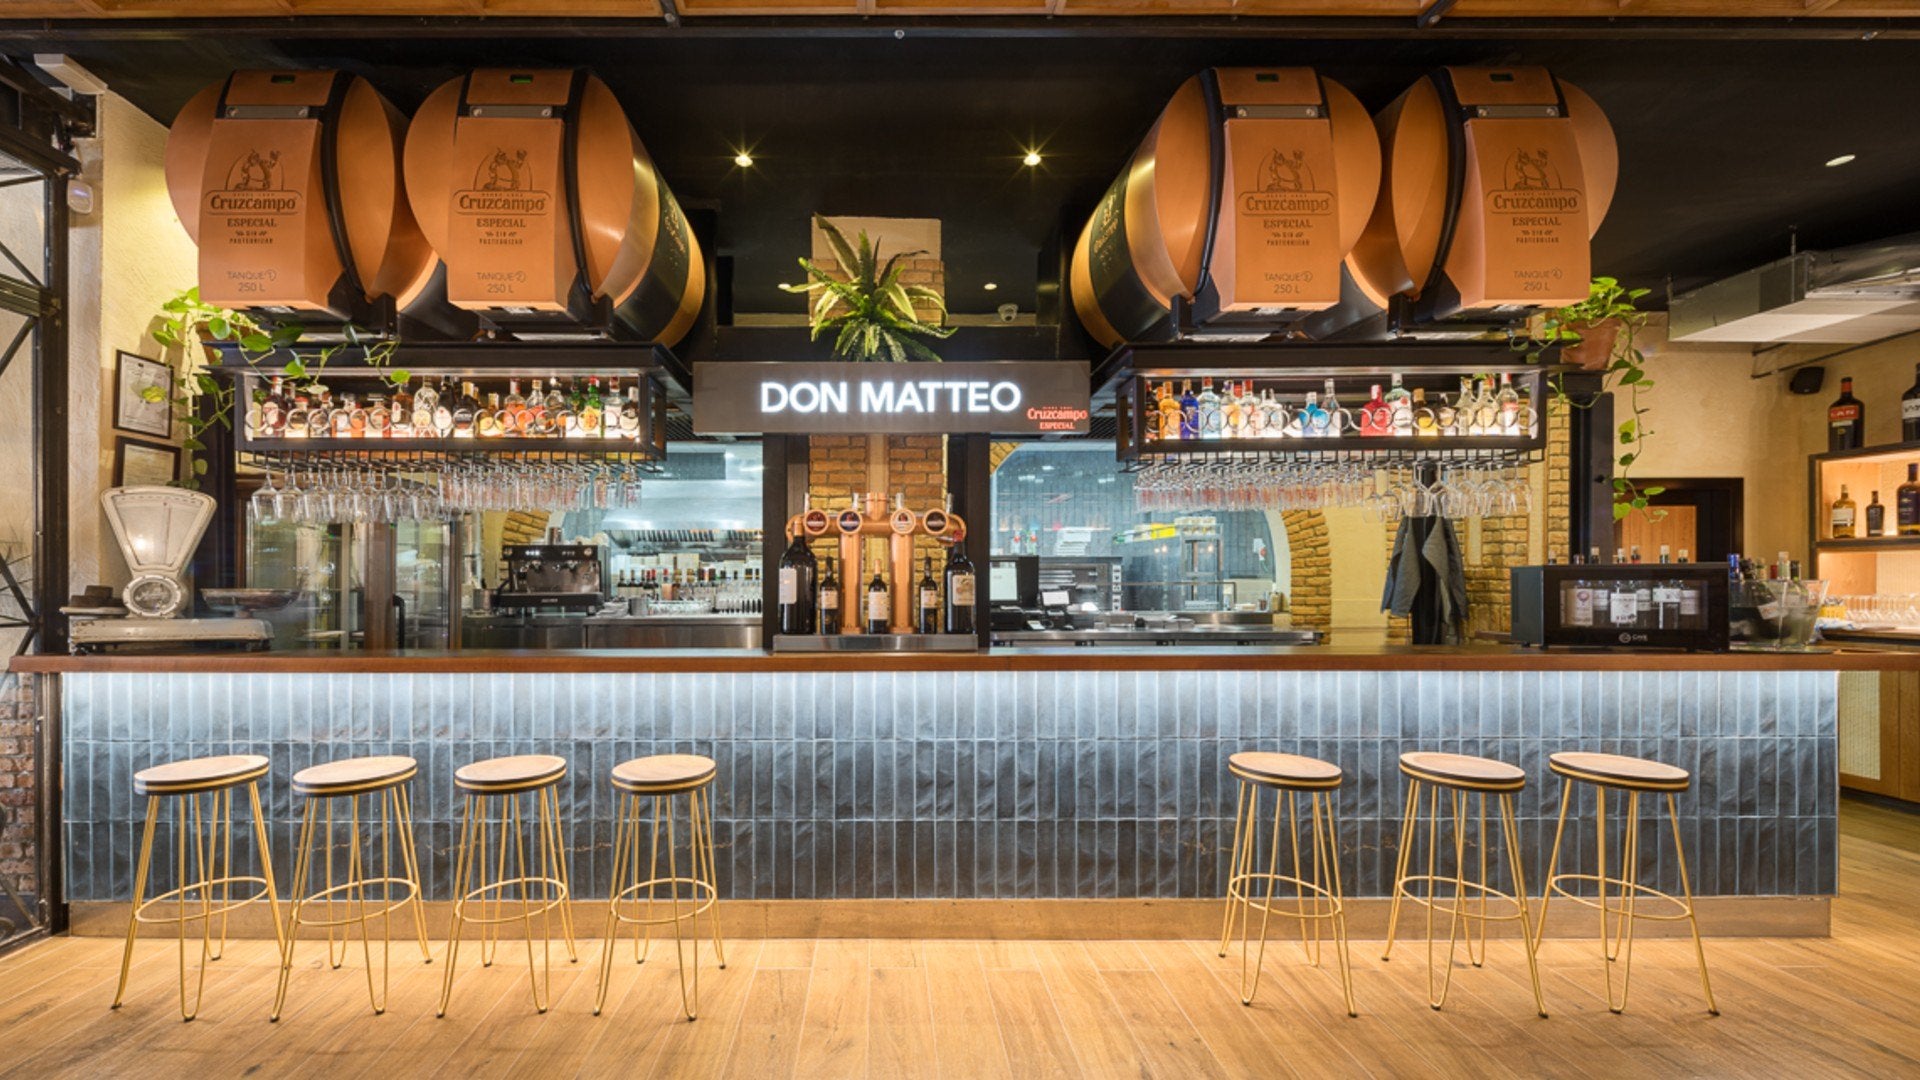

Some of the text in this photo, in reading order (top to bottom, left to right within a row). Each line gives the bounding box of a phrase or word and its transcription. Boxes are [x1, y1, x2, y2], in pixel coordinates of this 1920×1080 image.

[210, 194, 296, 211] Cruzcampo
[459, 194, 545, 212] Cruzcampo
[1246, 196, 1329, 212] Cruzcampo
[1493, 194, 1577, 210] Cruzcampo
[227, 218, 277, 227] ESPECIAL
[476, 218, 526, 227] ESPECIAL
[1263, 219, 1313, 228] ESPECIAL
[1512, 217, 1561, 226] ESPECIAL
[238, 282, 256, 292] 250
[487, 283, 505, 293] 250
[1273, 284, 1292, 293] 250
[1523, 282, 1542, 291] 250
[760, 381, 1021, 414] DON MATTEO
[1027, 407, 1088, 421] Cruzcampo
[1039, 421, 1075, 430] ESPECIAL
